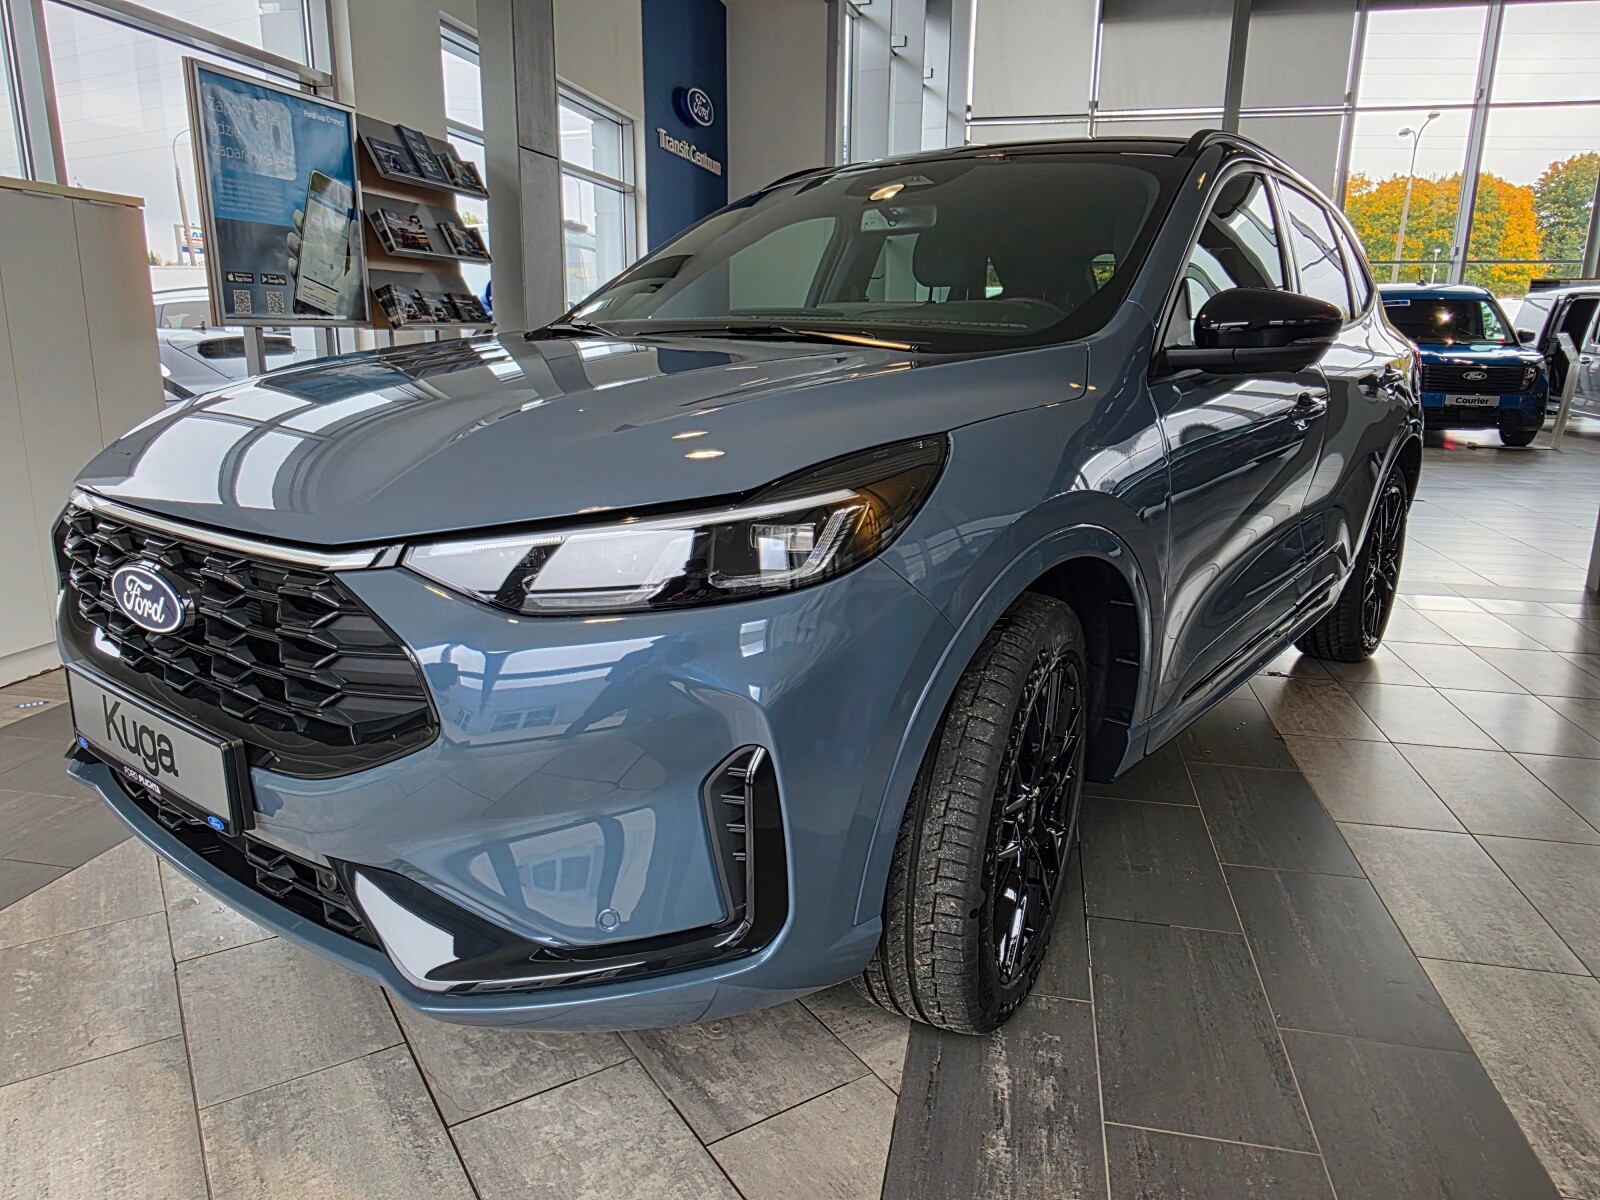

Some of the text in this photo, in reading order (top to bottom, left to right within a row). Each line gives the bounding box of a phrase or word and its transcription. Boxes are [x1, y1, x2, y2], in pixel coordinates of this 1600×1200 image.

[693, 92, 710, 121] Ford
[656, 127, 722, 176] Transit Centrum
[1455, 396, 1490, 405] Courier
[124, 575, 165, 623] Ford
[102, 694, 179, 777] Kuga
[124, 766, 139, 781] FORD
